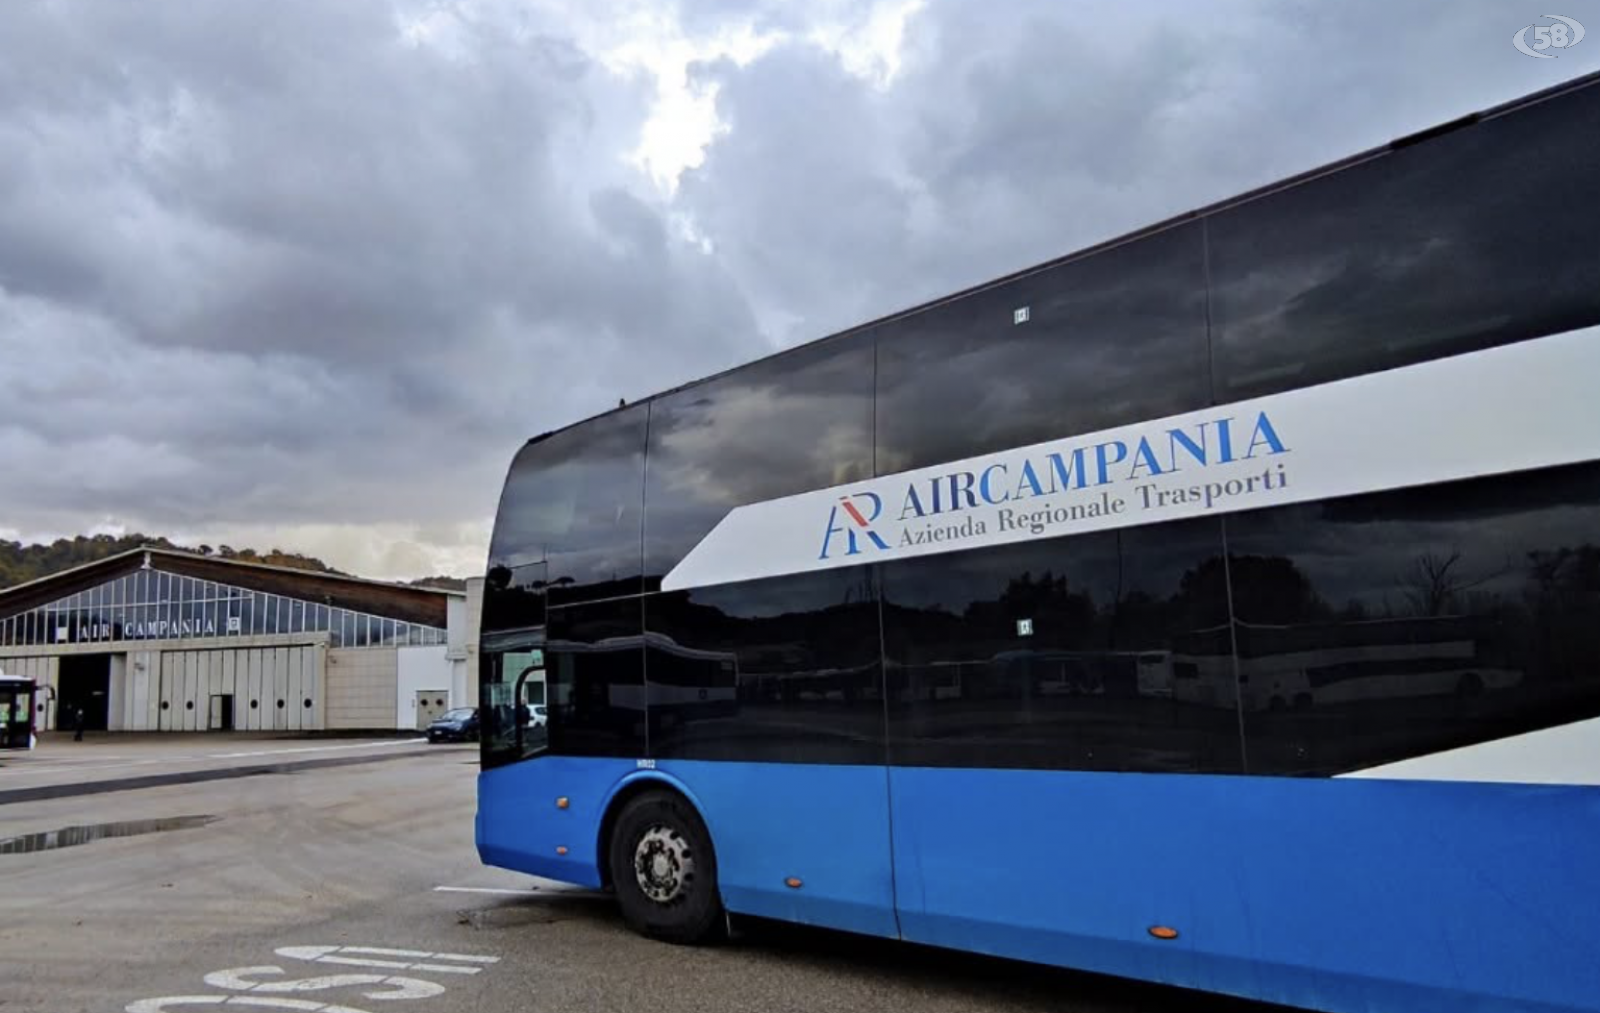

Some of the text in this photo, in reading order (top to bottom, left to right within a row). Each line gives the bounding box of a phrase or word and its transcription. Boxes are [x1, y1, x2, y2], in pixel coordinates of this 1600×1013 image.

[897, 411, 1292, 521] AIRCAMPANIA
[899, 463, 1288, 548] Azienda Regionale Trasporti
[80, 618, 215, 640] AIR CAMPANIA
